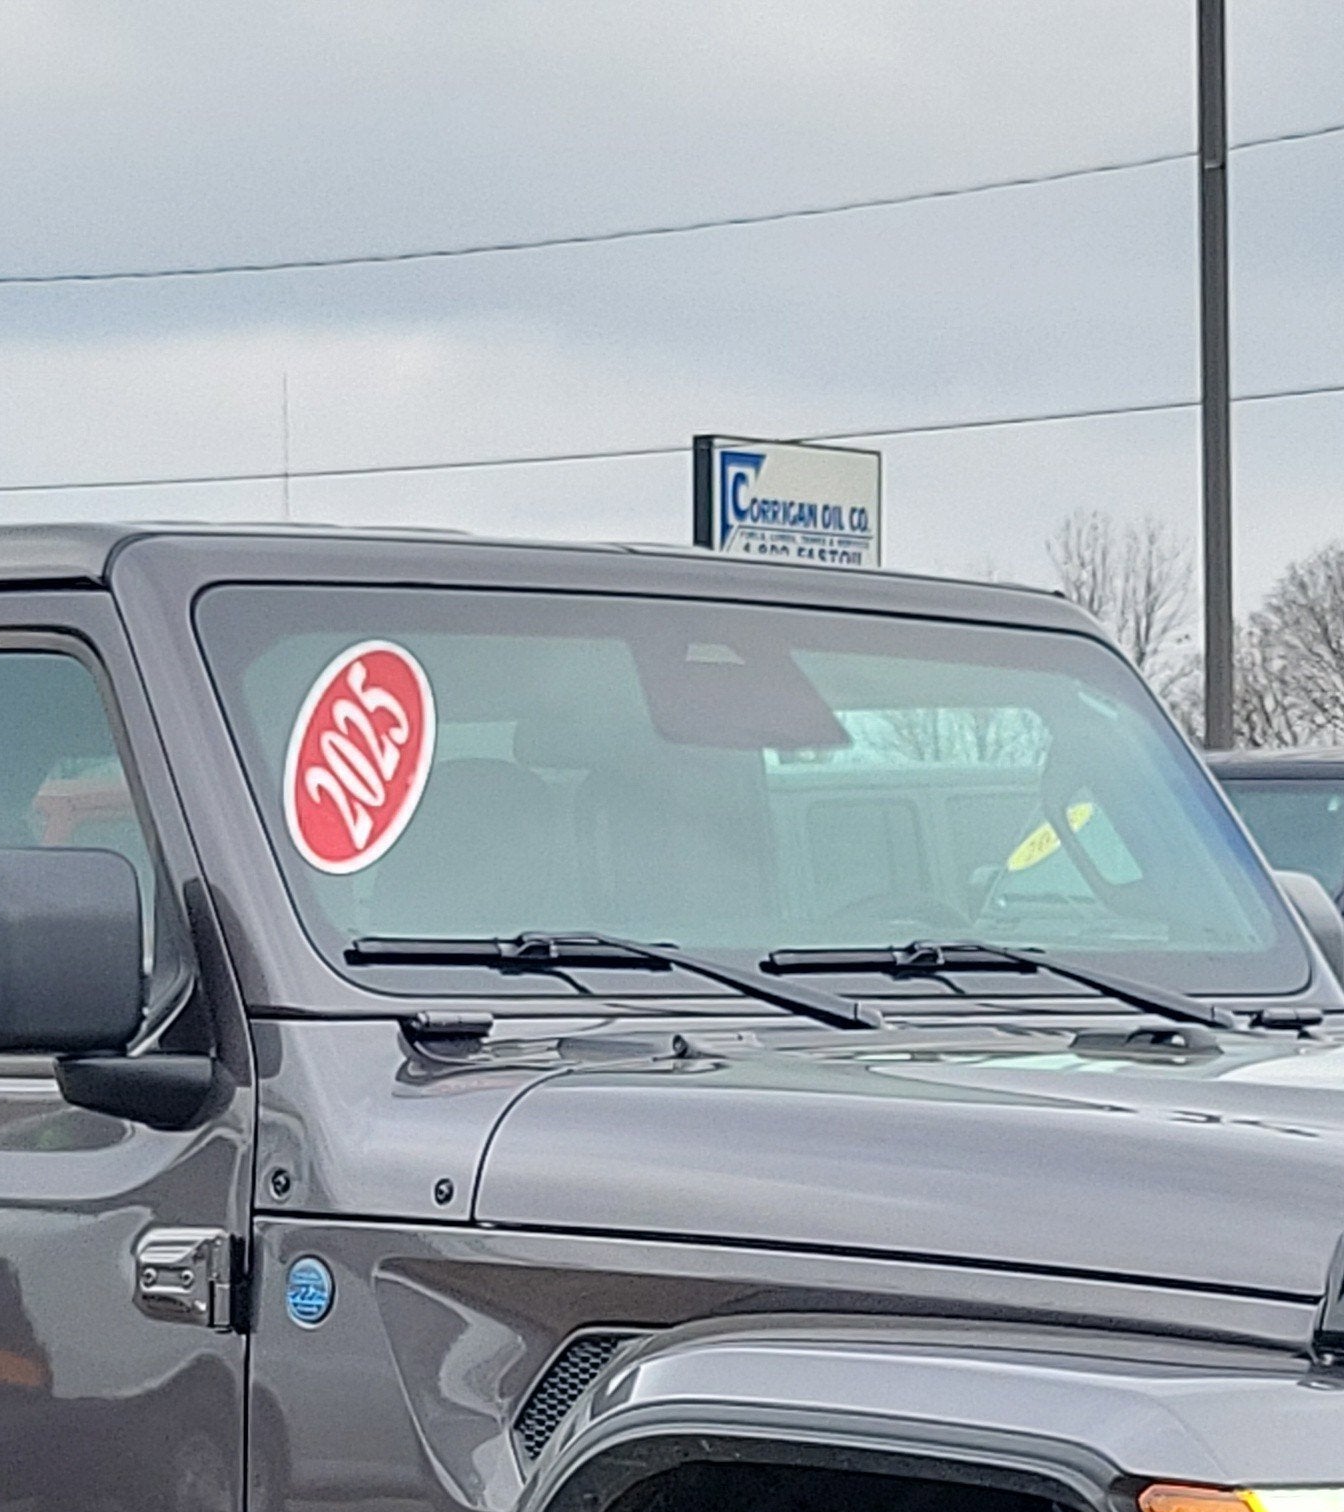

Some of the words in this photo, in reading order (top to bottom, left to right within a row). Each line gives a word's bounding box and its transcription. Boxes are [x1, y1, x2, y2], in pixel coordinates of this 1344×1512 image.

[731, 471, 818, 529] CORRIGAN
[821, 503, 845, 531] OIL
[305, 660, 411, 851] 2025
